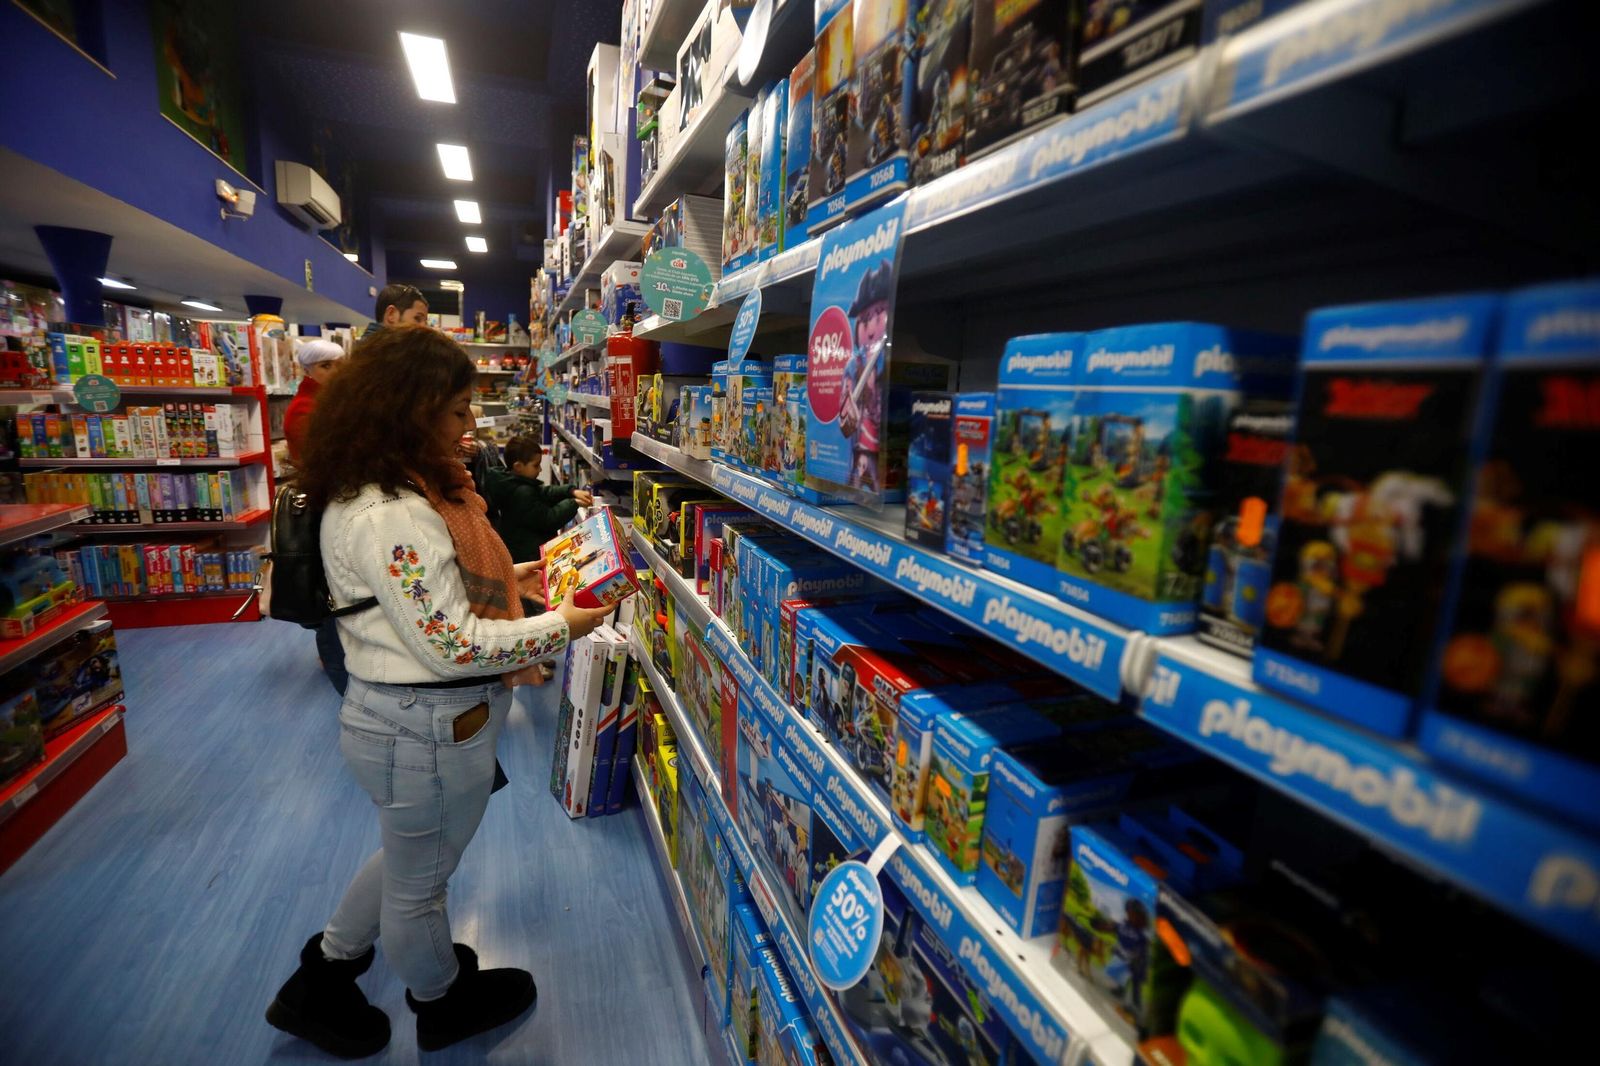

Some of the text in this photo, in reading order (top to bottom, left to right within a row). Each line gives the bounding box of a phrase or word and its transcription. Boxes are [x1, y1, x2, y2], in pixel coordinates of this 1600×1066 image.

[1029, 81, 1184, 179] playmobil
[821, 217, 899, 280] playmobil
[812, 331, 845, 365] 50%
[1007, 350, 1073, 373] playmobil
[1087, 344, 1174, 373] playmobil
[911, 399, 951, 415] playmobil
[731, 480, 757, 500] playmobil
[757, 492, 791, 517] playmobil
[791, 507, 834, 539] playmobil
[835, 528, 893, 567] playmobil
[895, 554, 977, 608] playmobil
[983, 596, 1107, 670] playmobil
[787, 573, 864, 596] playmobil
[873, 674, 899, 698] CITY
[778, 745, 853, 842] playmobil playmobil
[994, 761, 1036, 798] playmobil
[1199, 697, 1482, 853] playmobil
[728, 653, 754, 687] playmobil
[753, 683, 784, 724] playmobil
[785, 724, 824, 774] playmobil
[827, 774, 879, 842] playmobil
[893, 857, 954, 929] aymobil
[957, 935, 1068, 1062] playmobil
[1077, 843, 1129, 887] playmobil
[831, 880, 871, 940] 50%
[762, 947, 797, 1003] playmobil
[779, 931, 816, 998] playmobil
